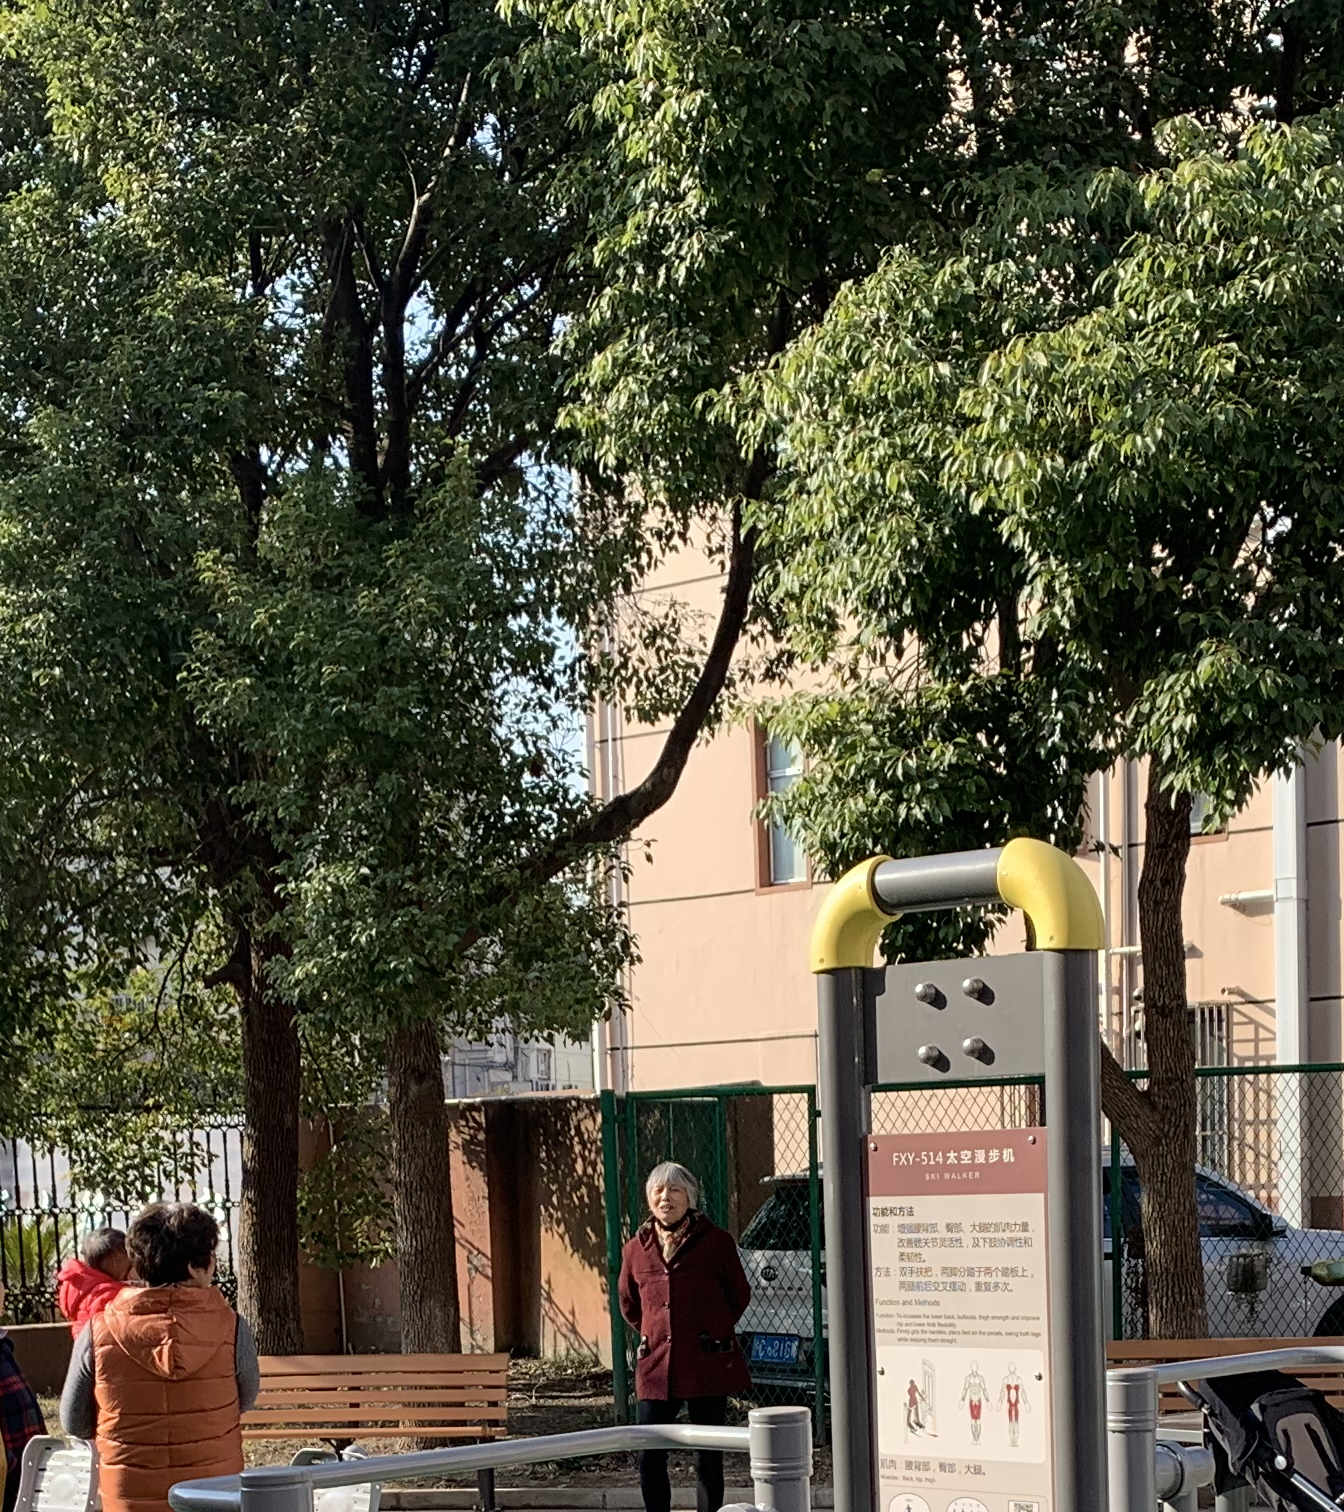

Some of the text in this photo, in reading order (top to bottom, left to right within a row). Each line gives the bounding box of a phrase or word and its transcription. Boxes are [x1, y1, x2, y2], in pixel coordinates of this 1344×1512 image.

[892, 1148, 1016, 1166] FXY-514 太空漫步机
[944, 1171, 981, 1181] WALKER
[872, 1206, 915, 1217] 功能和方法
